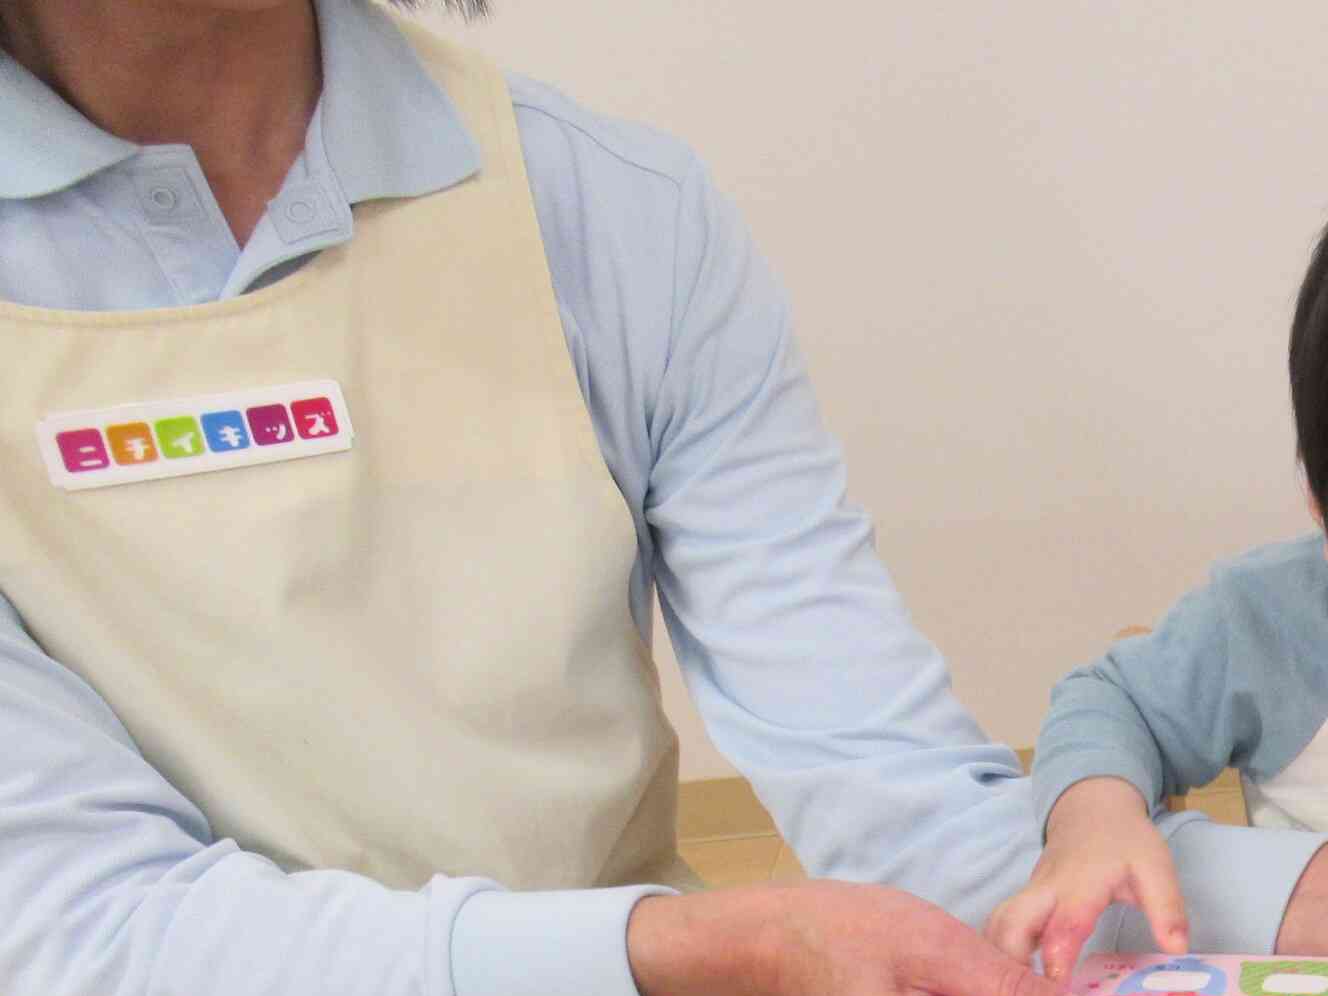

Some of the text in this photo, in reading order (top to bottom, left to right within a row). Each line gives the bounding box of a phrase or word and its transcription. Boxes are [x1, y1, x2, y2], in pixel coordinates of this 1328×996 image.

[66, 400, 336, 470] ニチイキッズ
